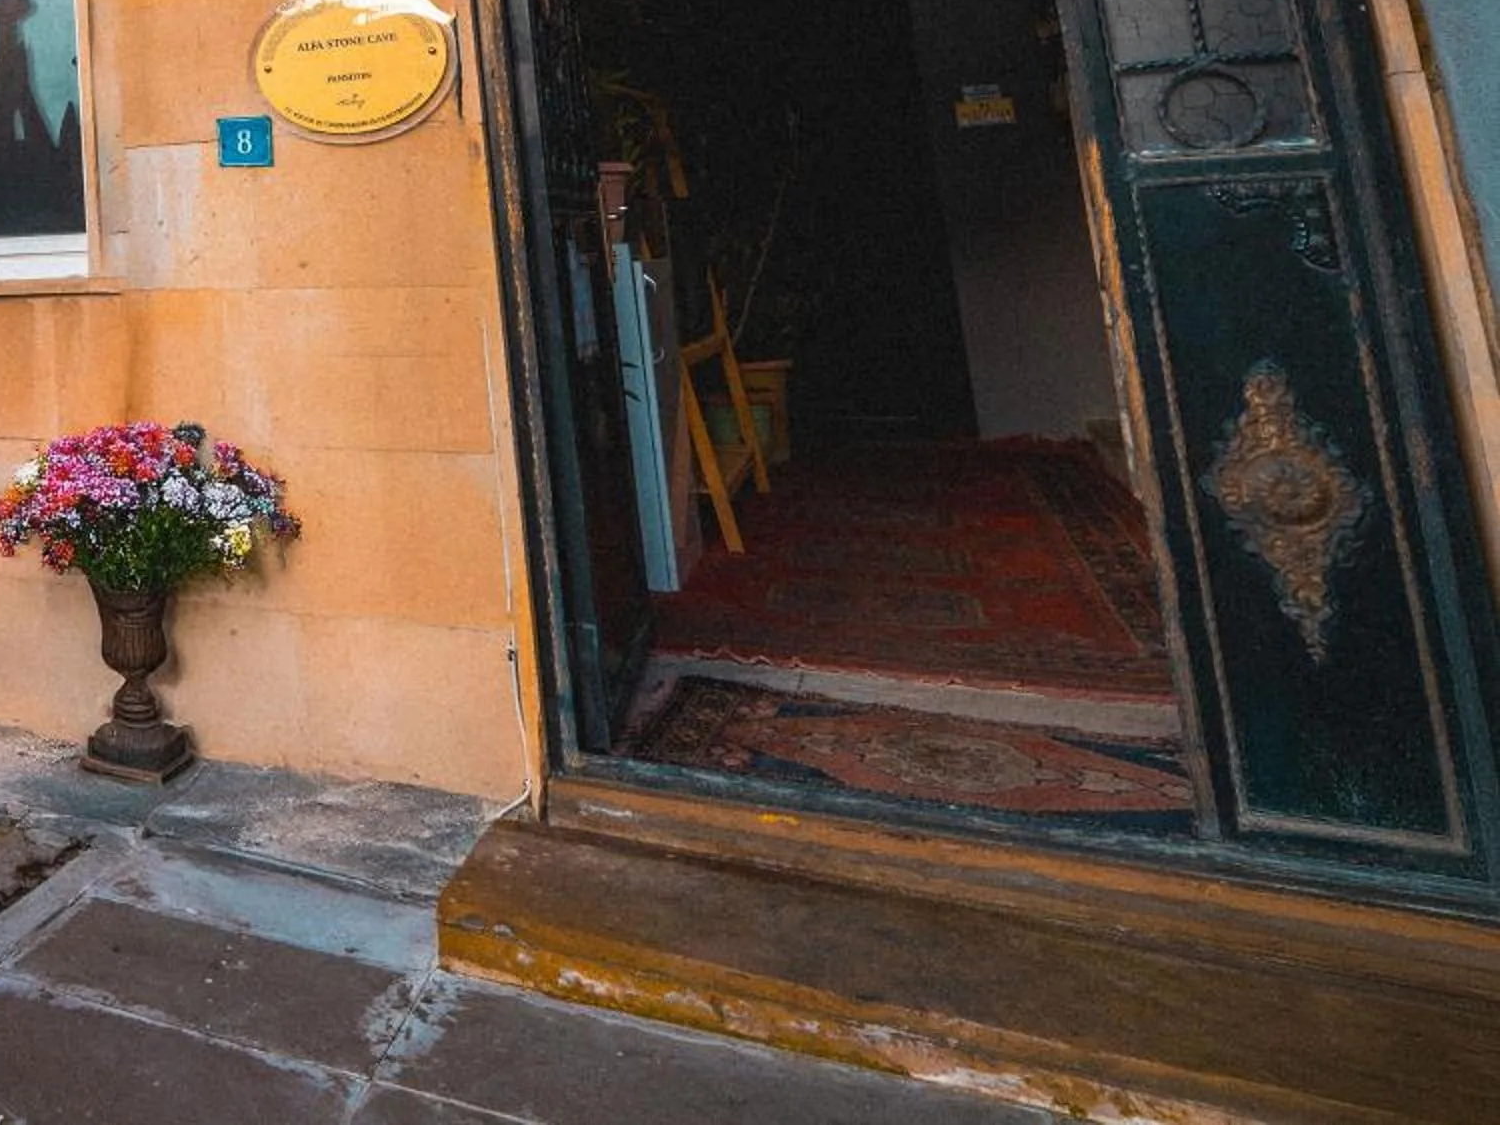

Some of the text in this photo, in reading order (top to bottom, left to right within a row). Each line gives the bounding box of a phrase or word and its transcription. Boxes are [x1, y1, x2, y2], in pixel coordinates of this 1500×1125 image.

[296, 32, 397, 53] ALFA STONE CAVE
[236, 128, 253, 155] 8
